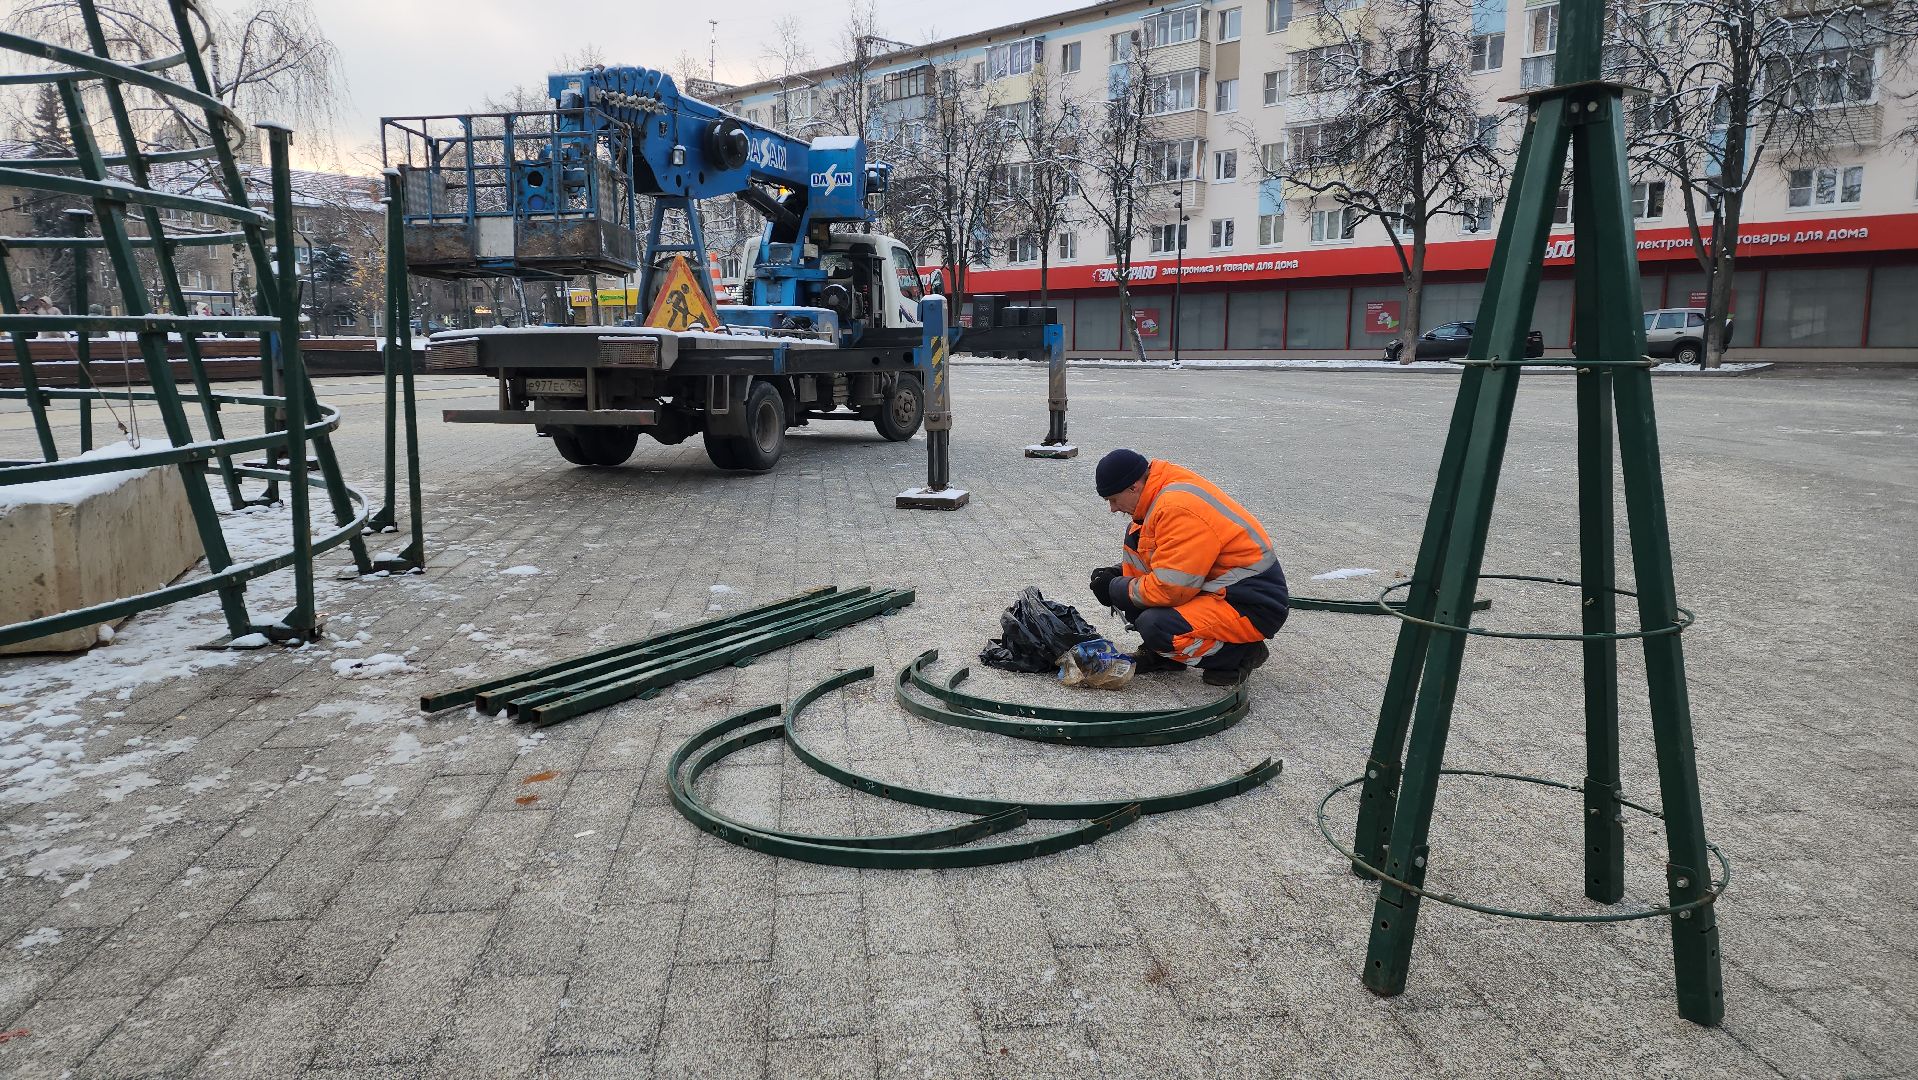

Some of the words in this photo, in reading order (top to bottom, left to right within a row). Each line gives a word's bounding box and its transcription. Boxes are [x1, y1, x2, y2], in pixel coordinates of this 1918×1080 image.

[811, 164, 852, 196] DASAN
[1737, 233, 1790, 245] товары
[1794, 230, 1824, 242] для
[1826, 227, 1869, 240] дома
[1223, 263, 1254, 272] товары
[1256, 261, 1273, 271] для
[1275, 259, 1299, 270] дома
